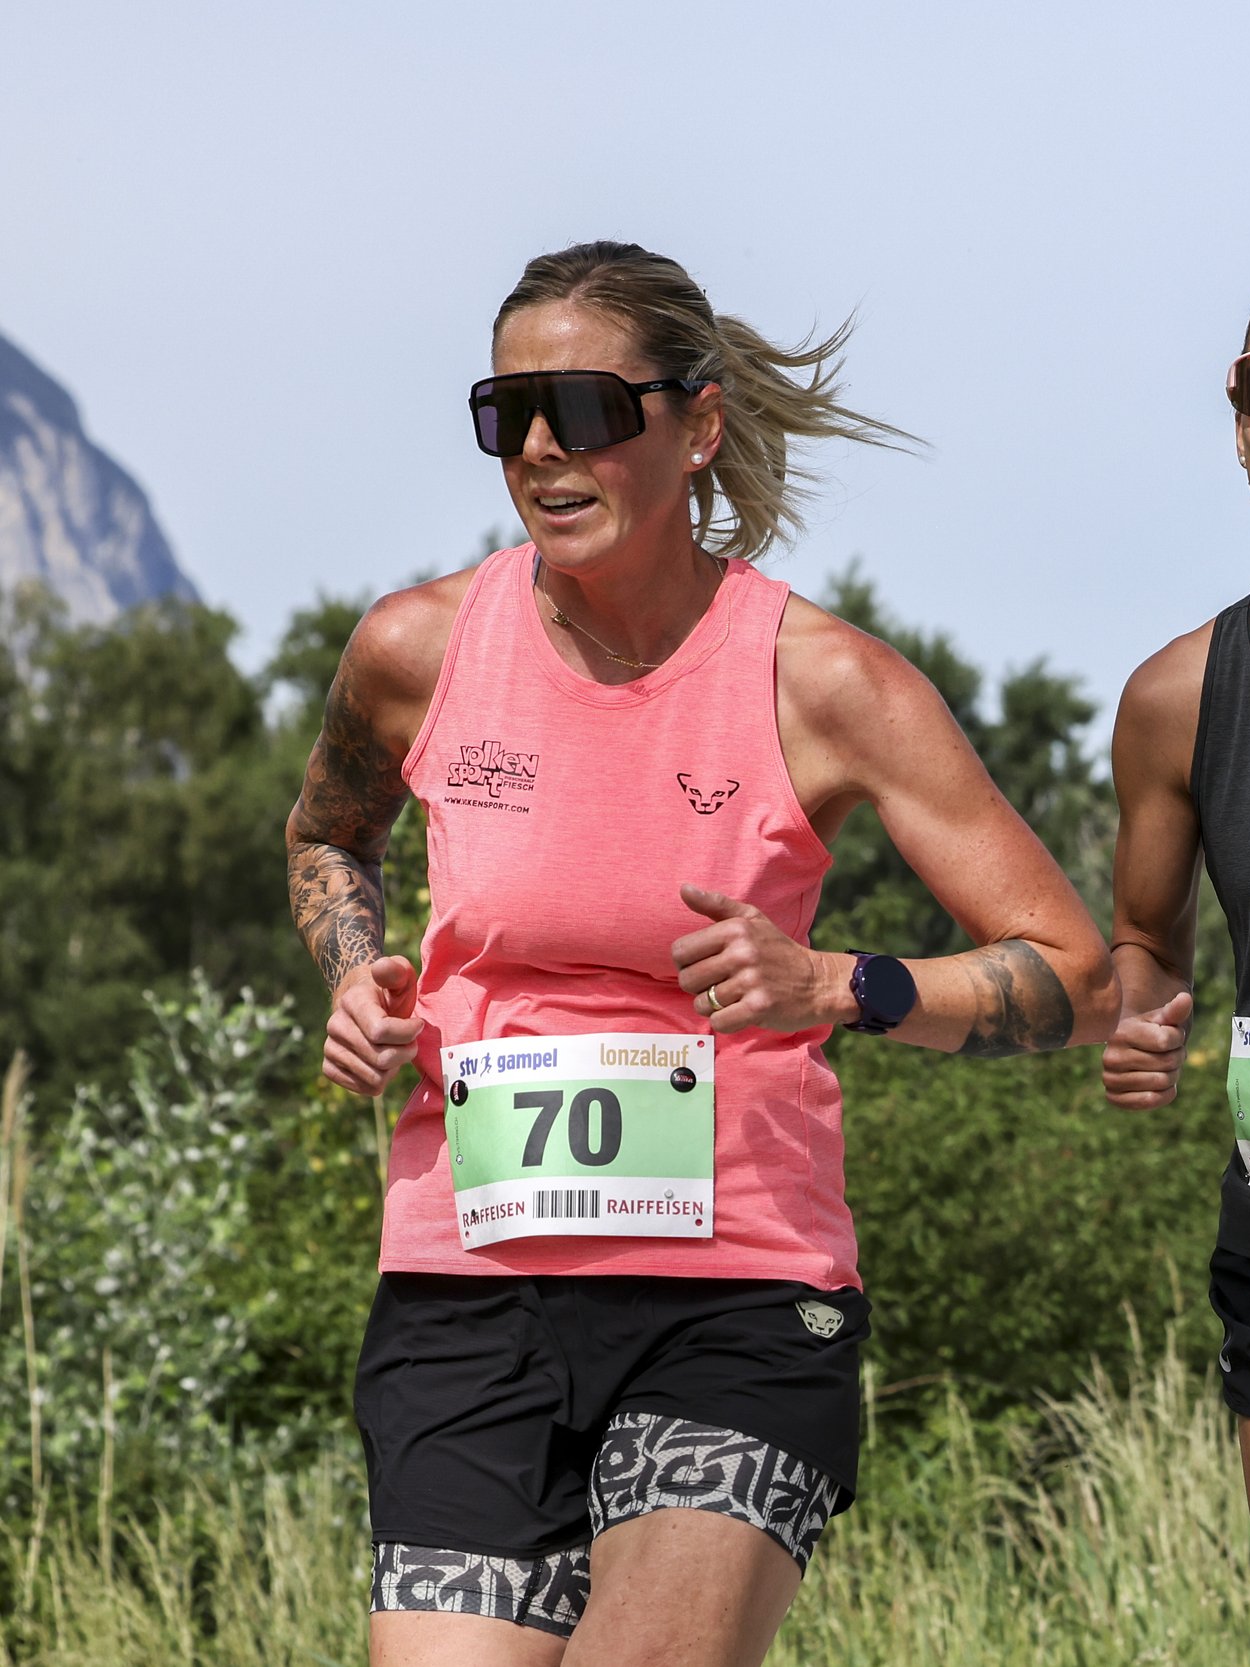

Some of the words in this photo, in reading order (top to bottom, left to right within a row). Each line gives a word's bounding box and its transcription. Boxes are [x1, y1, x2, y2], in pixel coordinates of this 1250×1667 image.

[503, 780, 535, 791] FIESCH
[460, 1056, 478, 1077] stv
[497, 1048, 558, 1073] gampel
[600, 1043, 689, 1069] lonzalauf
[513, 1087, 623, 1168] 70
[462, 1201, 525, 1228] RAIFFEISEN
[607, 1198, 704, 1216] RAIFFEISEN
